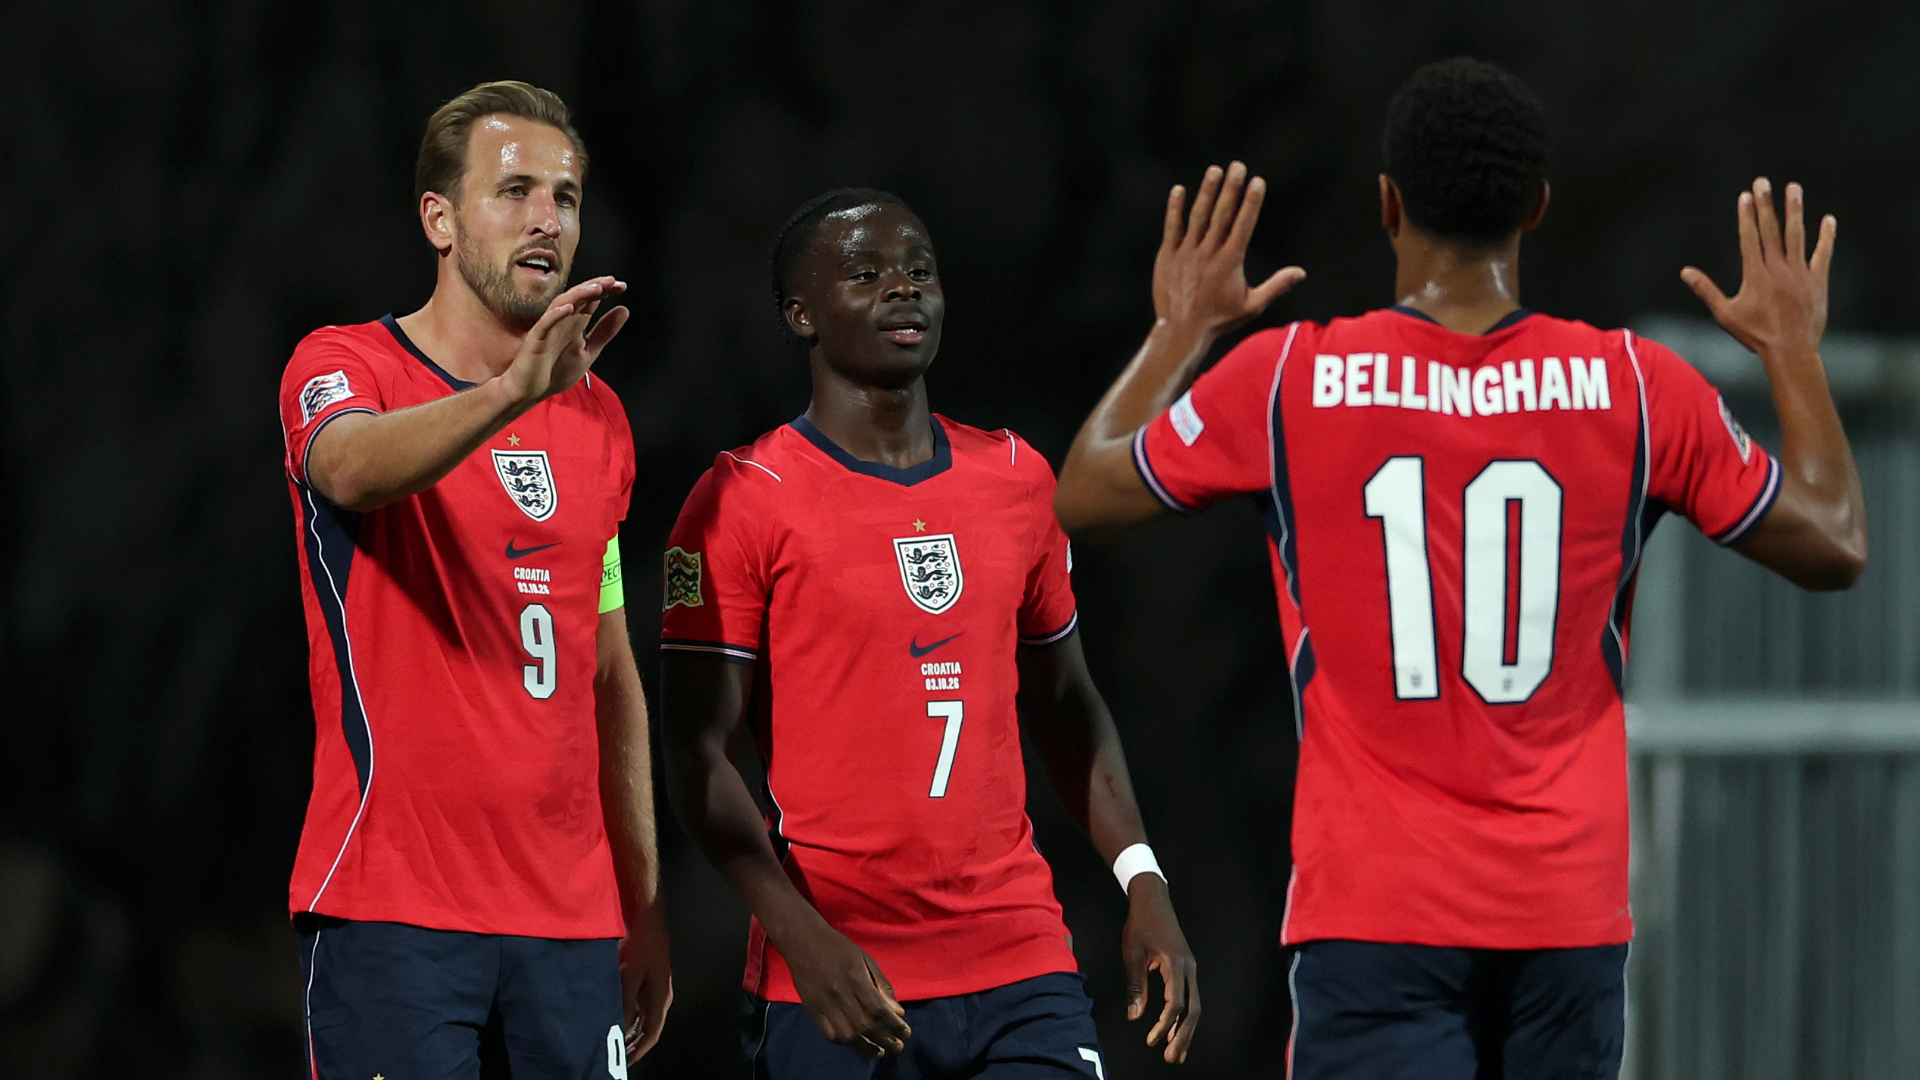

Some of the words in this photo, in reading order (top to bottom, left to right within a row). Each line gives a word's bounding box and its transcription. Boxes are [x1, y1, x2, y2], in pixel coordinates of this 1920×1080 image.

[1313, 353, 1611, 417] BELLINGHAM
[514, 567, 550, 582] CROATIA
[517, 582, 550, 594] 03.10.26
[1363, 456, 1563, 705] 10
[520, 603, 557, 700] 9
[921, 661, 962, 676] CROATIA
[925, 677, 960, 690] 03.10.26
[926, 700, 964, 798] 7
[607, 1024, 628, 1080] 9
